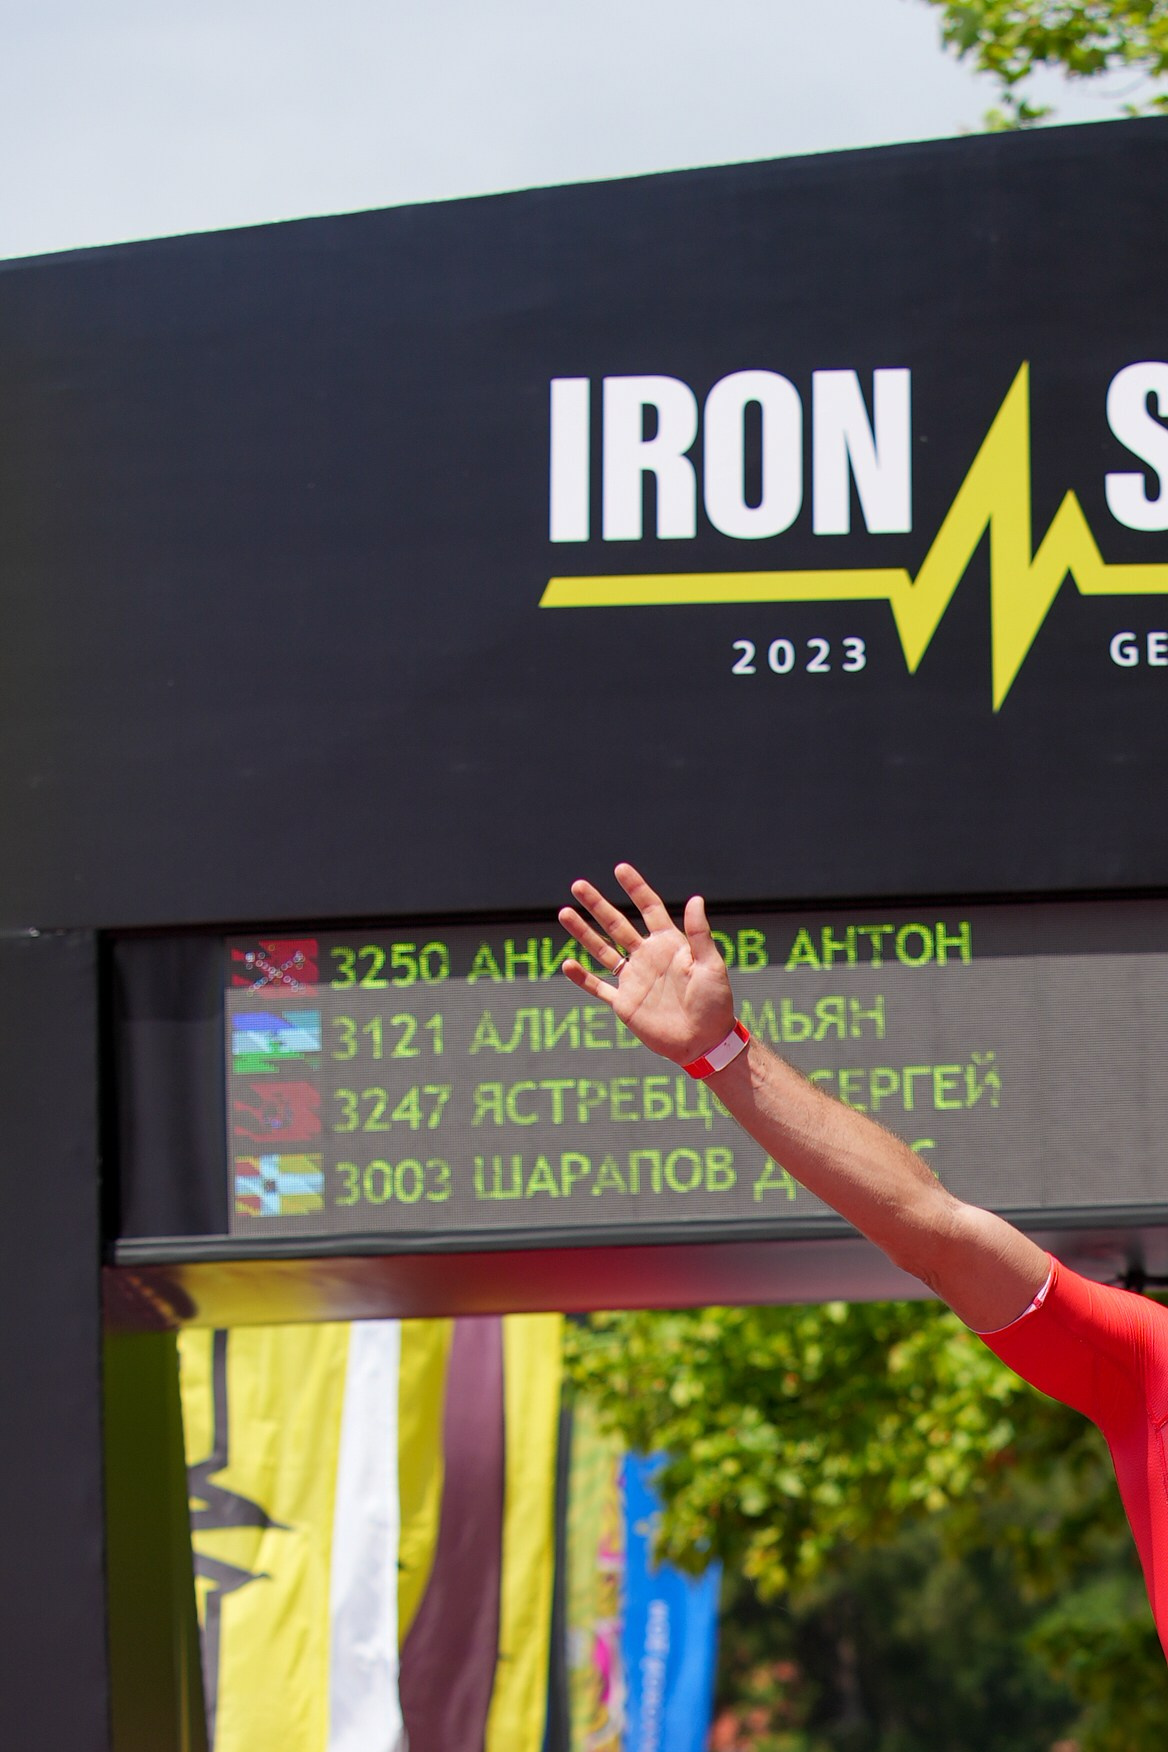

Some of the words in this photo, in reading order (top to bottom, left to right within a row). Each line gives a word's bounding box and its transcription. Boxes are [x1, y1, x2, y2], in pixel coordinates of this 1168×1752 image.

[549, 367, 912, 543] IRON
[731, 636, 868, 675] 2023
[330, 941, 450, 990] 3250
[467, 927, 769, 985] АНИСОВ
[784, 921, 972, 973] АНТОН
[331, 1012, 445, 1061] 3121
[740, 994, 886, 1043] МЬЯН
[332, 1084, 451, 1132] 3247
[471, 1074, 734, 1130] ЯСТРЕБЦ
[335, 1157, 452, 1206] 3003
[473, 1146, 737, 1200] ШАРАПОВ
